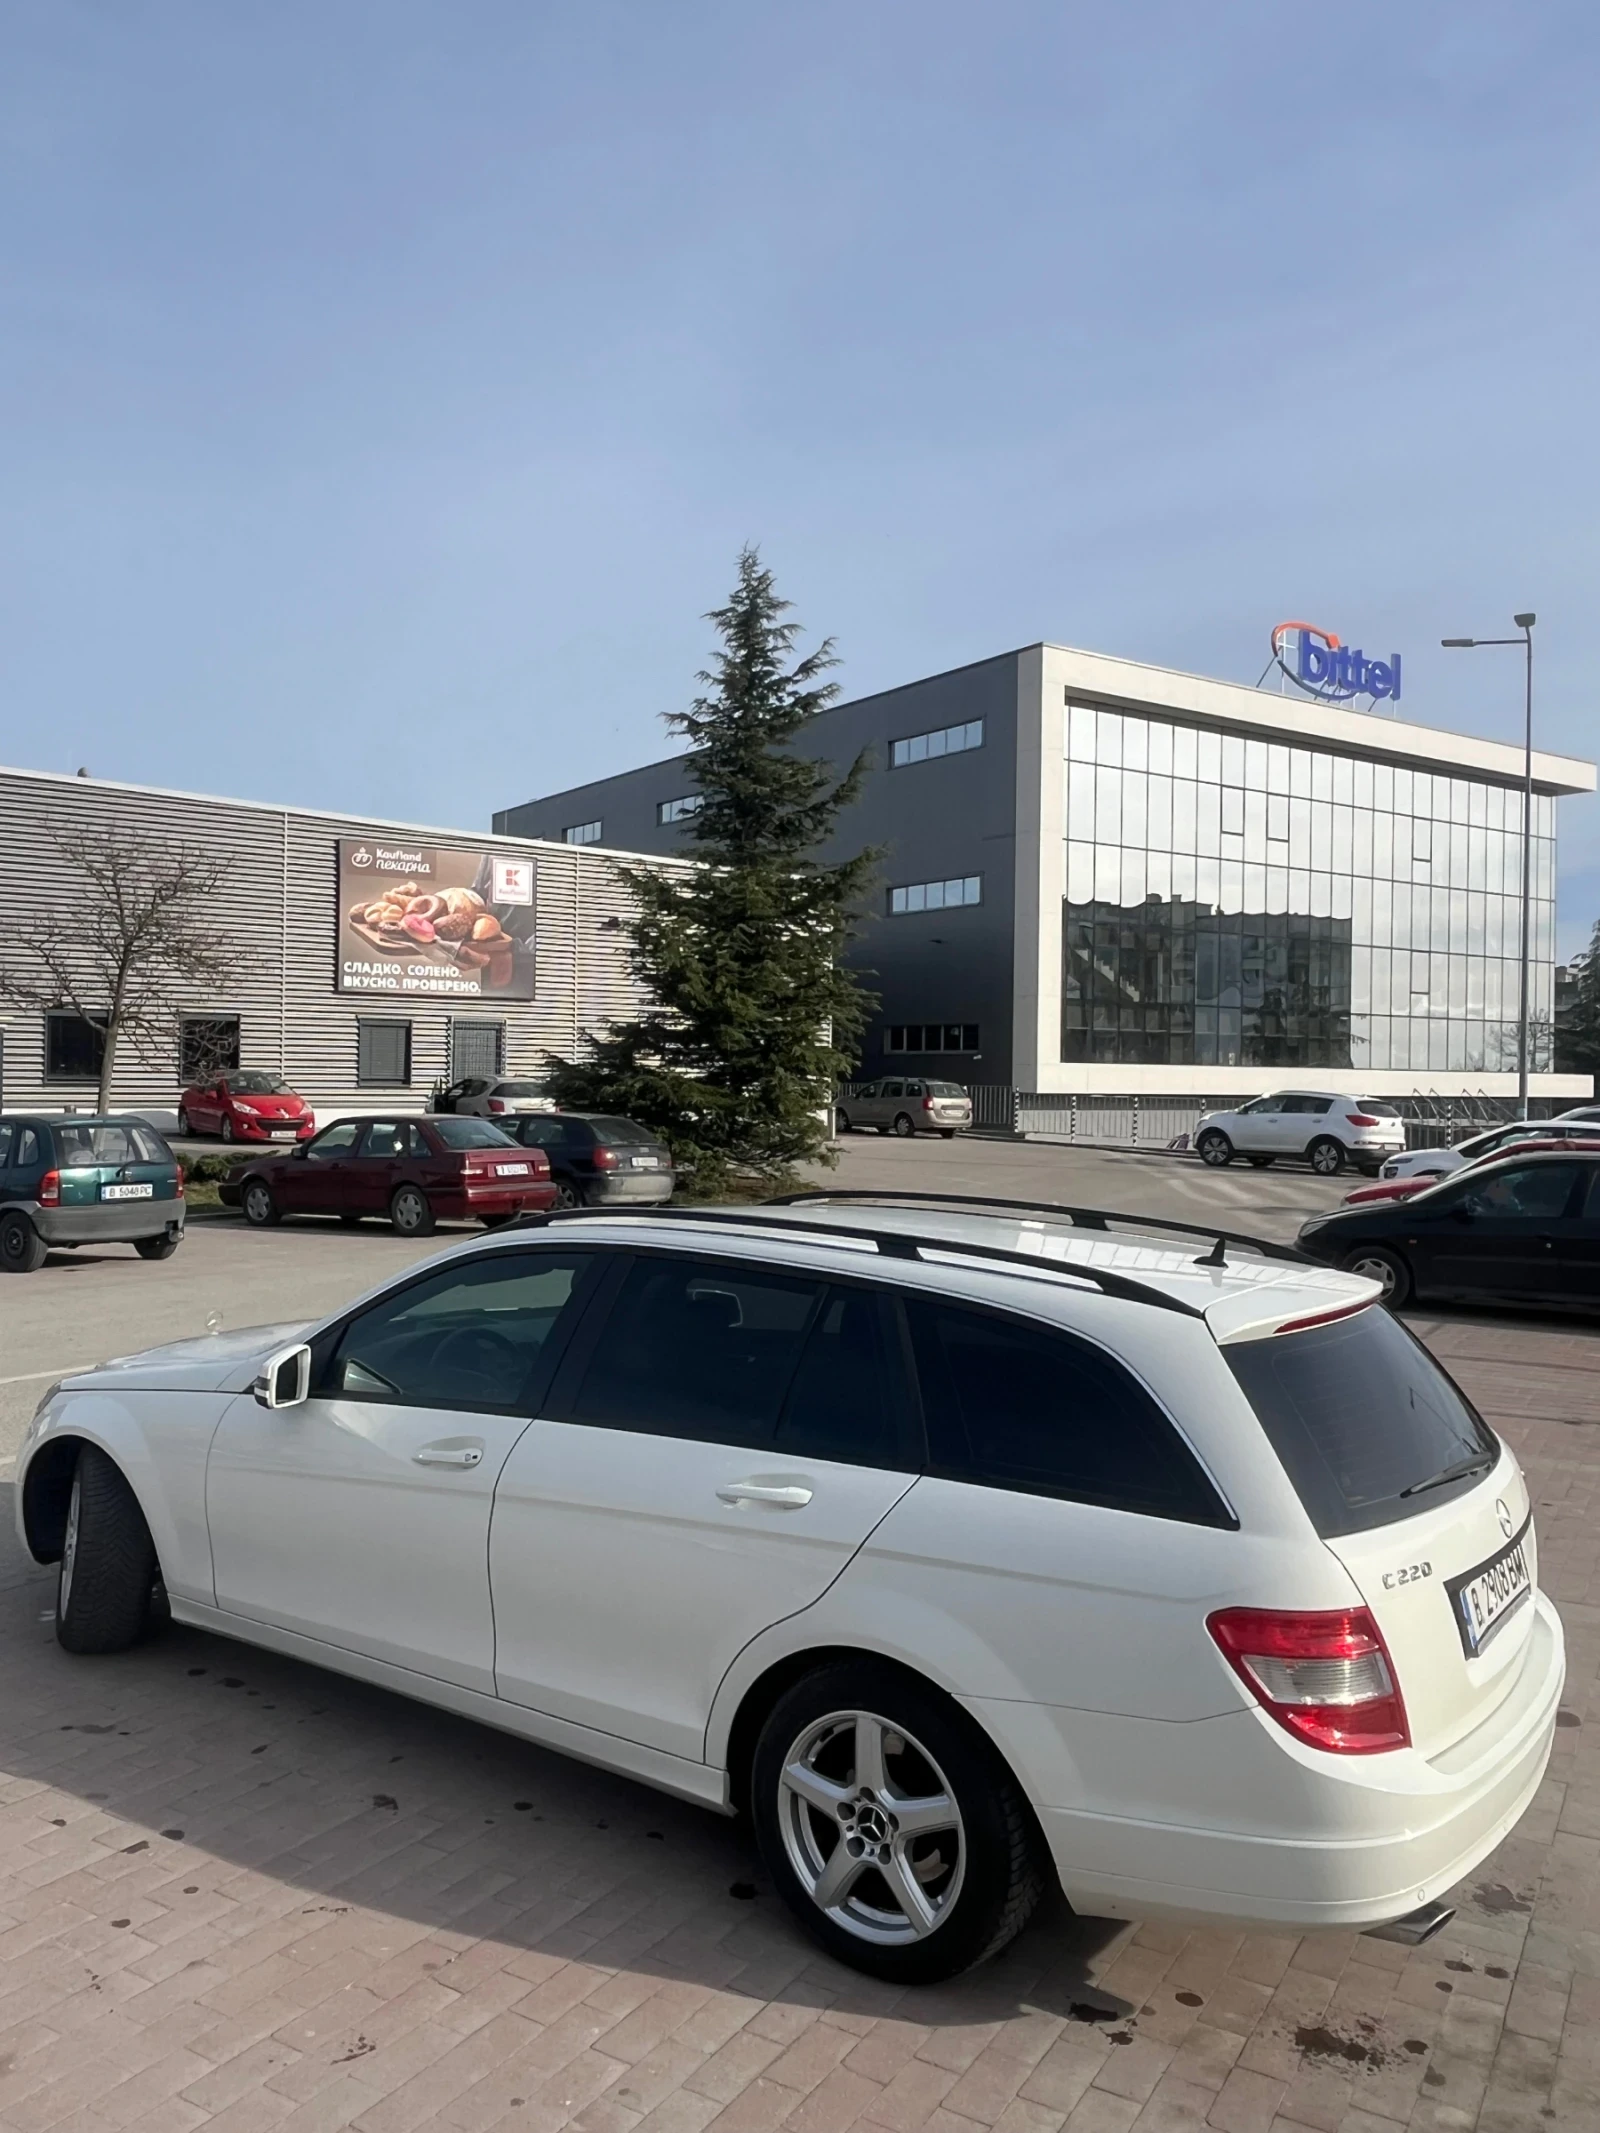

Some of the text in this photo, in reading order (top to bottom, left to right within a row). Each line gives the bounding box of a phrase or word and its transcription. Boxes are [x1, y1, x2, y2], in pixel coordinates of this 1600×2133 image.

[1298, 629, 1401, 700] bittel
[376, 848, 422, 861] Kaufland
[343, 962, 462, 977] СЛАДКО. СОЛЕНО.
[343, 975, 481, 992] ВКУСНО. ПРОВЕРЕНО.
